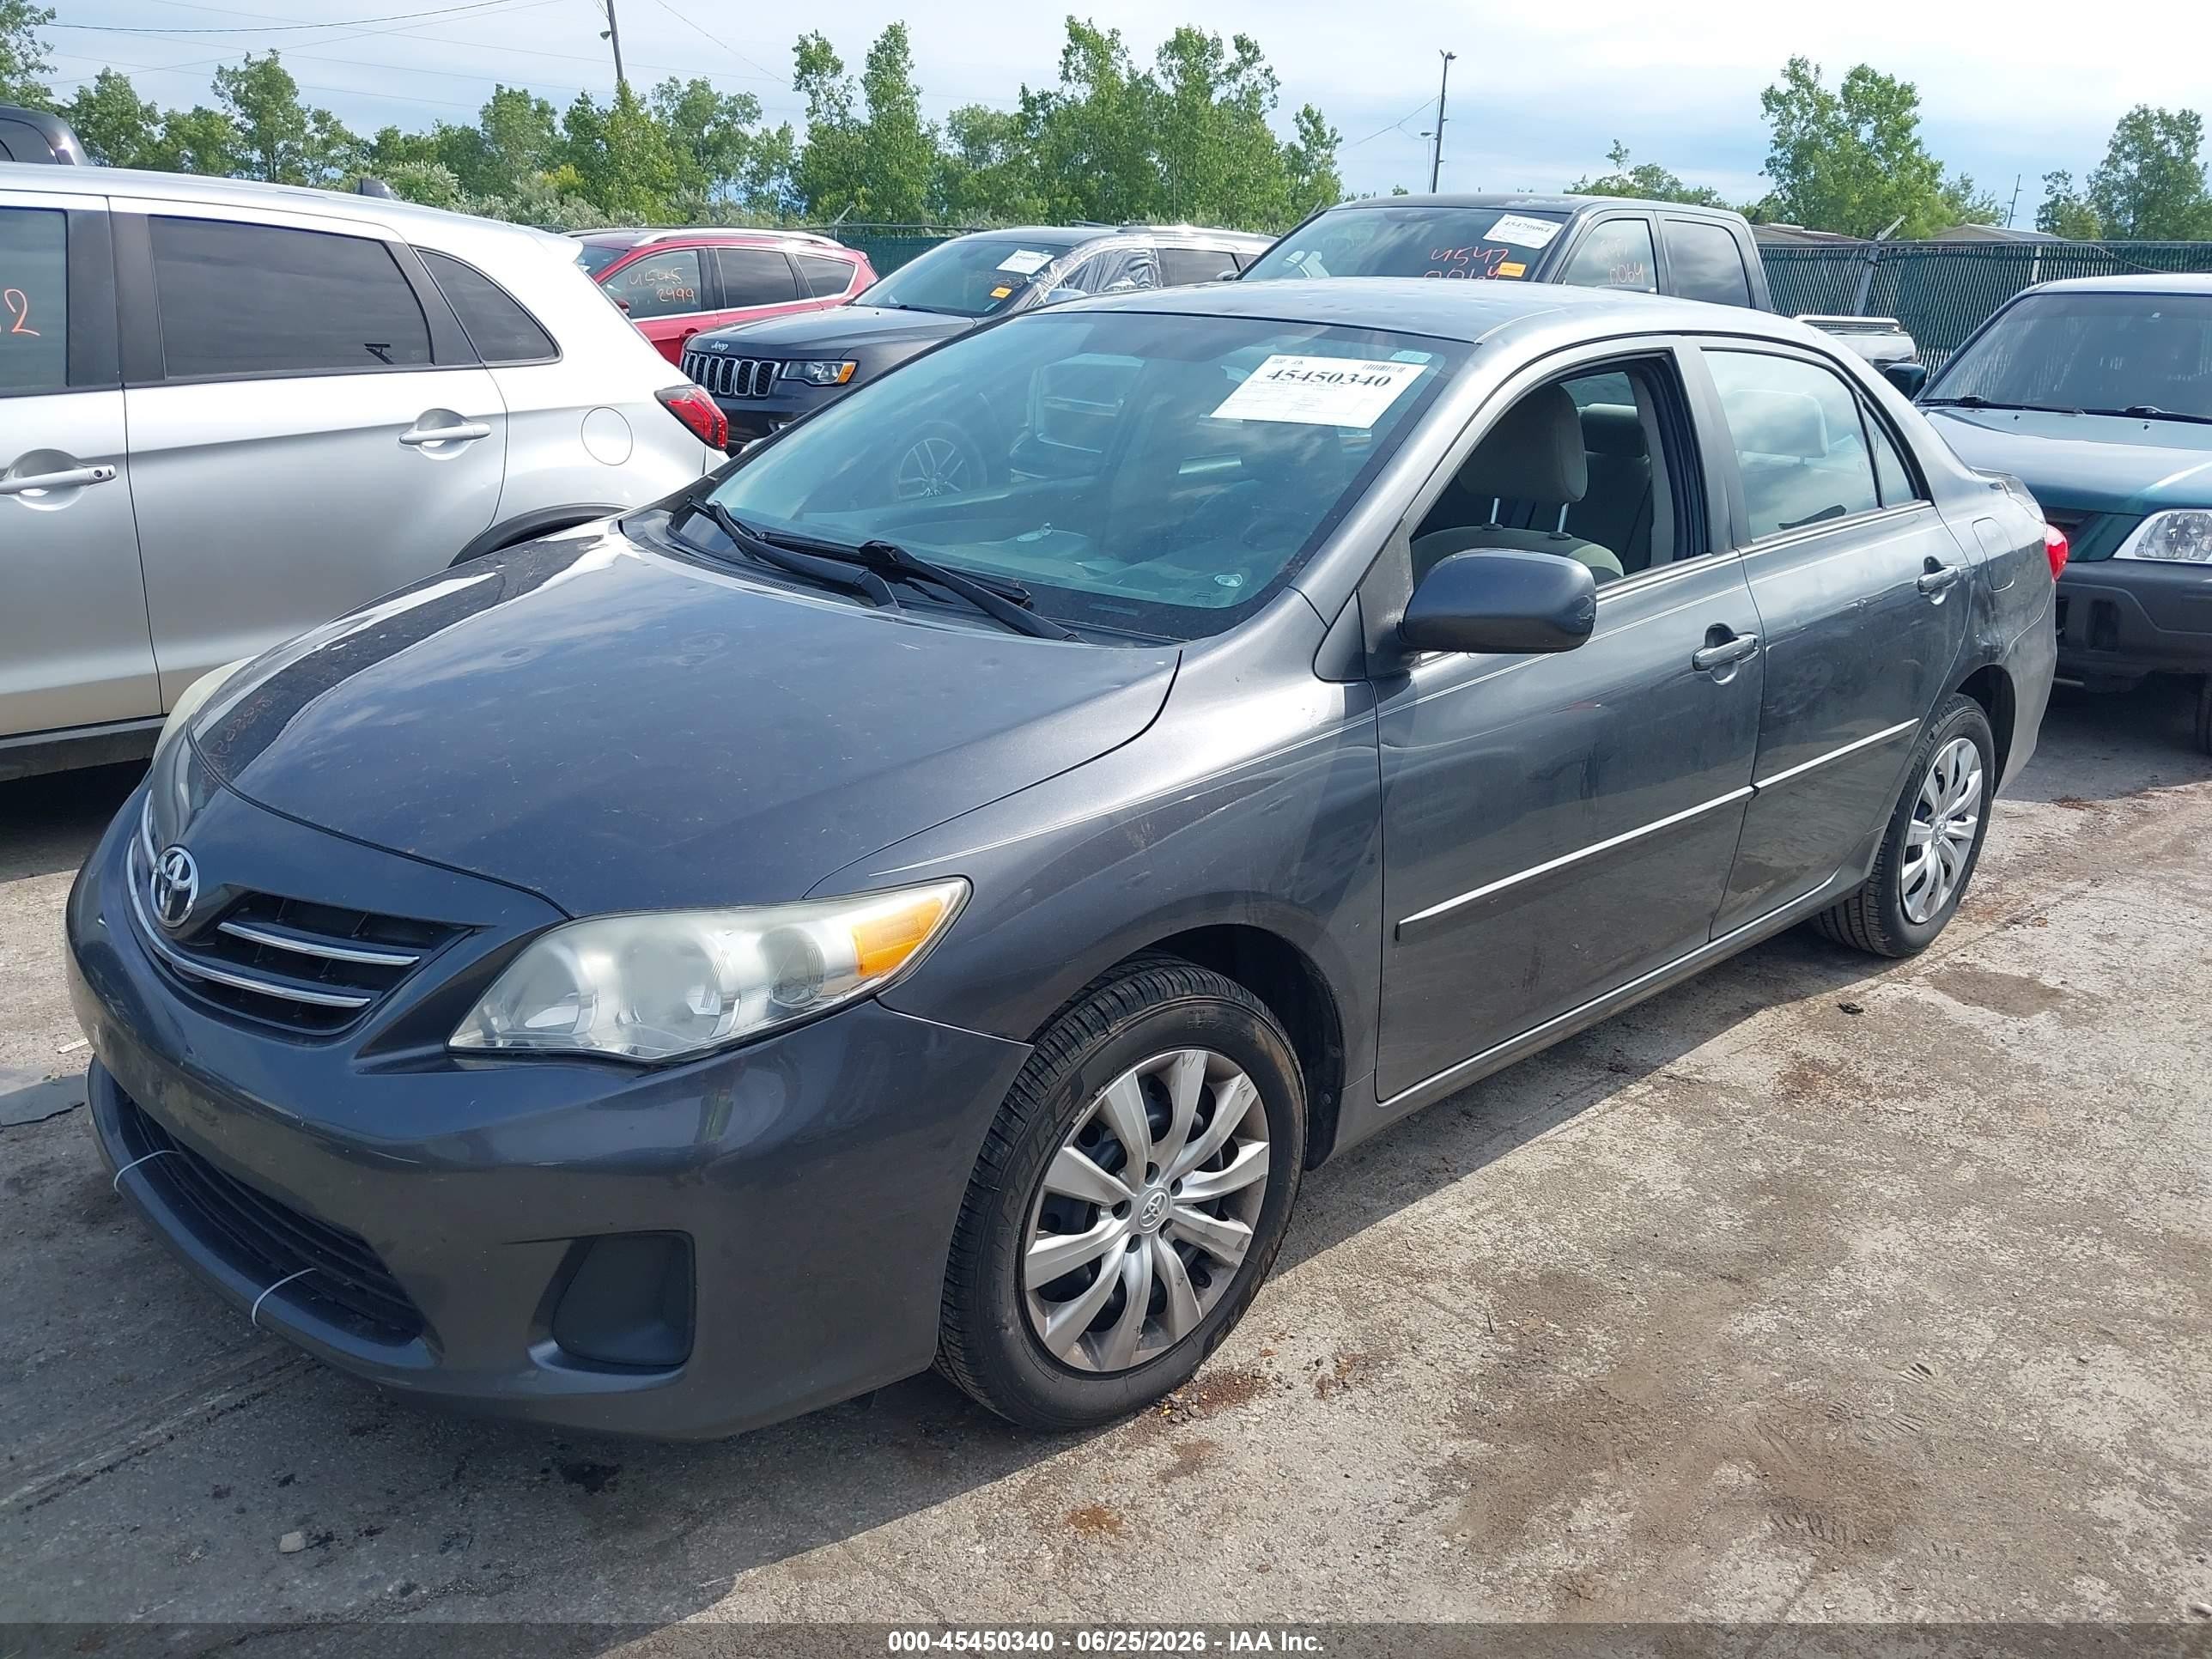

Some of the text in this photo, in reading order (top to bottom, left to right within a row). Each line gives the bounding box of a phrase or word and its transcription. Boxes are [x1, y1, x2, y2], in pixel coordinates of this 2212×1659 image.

[1431, 246, 1510, 266] 4547
[656, 287, 697, 304] 2999
[0, 289, 40, 336] 2
[1266, 369, 1392, 387] 45450340
